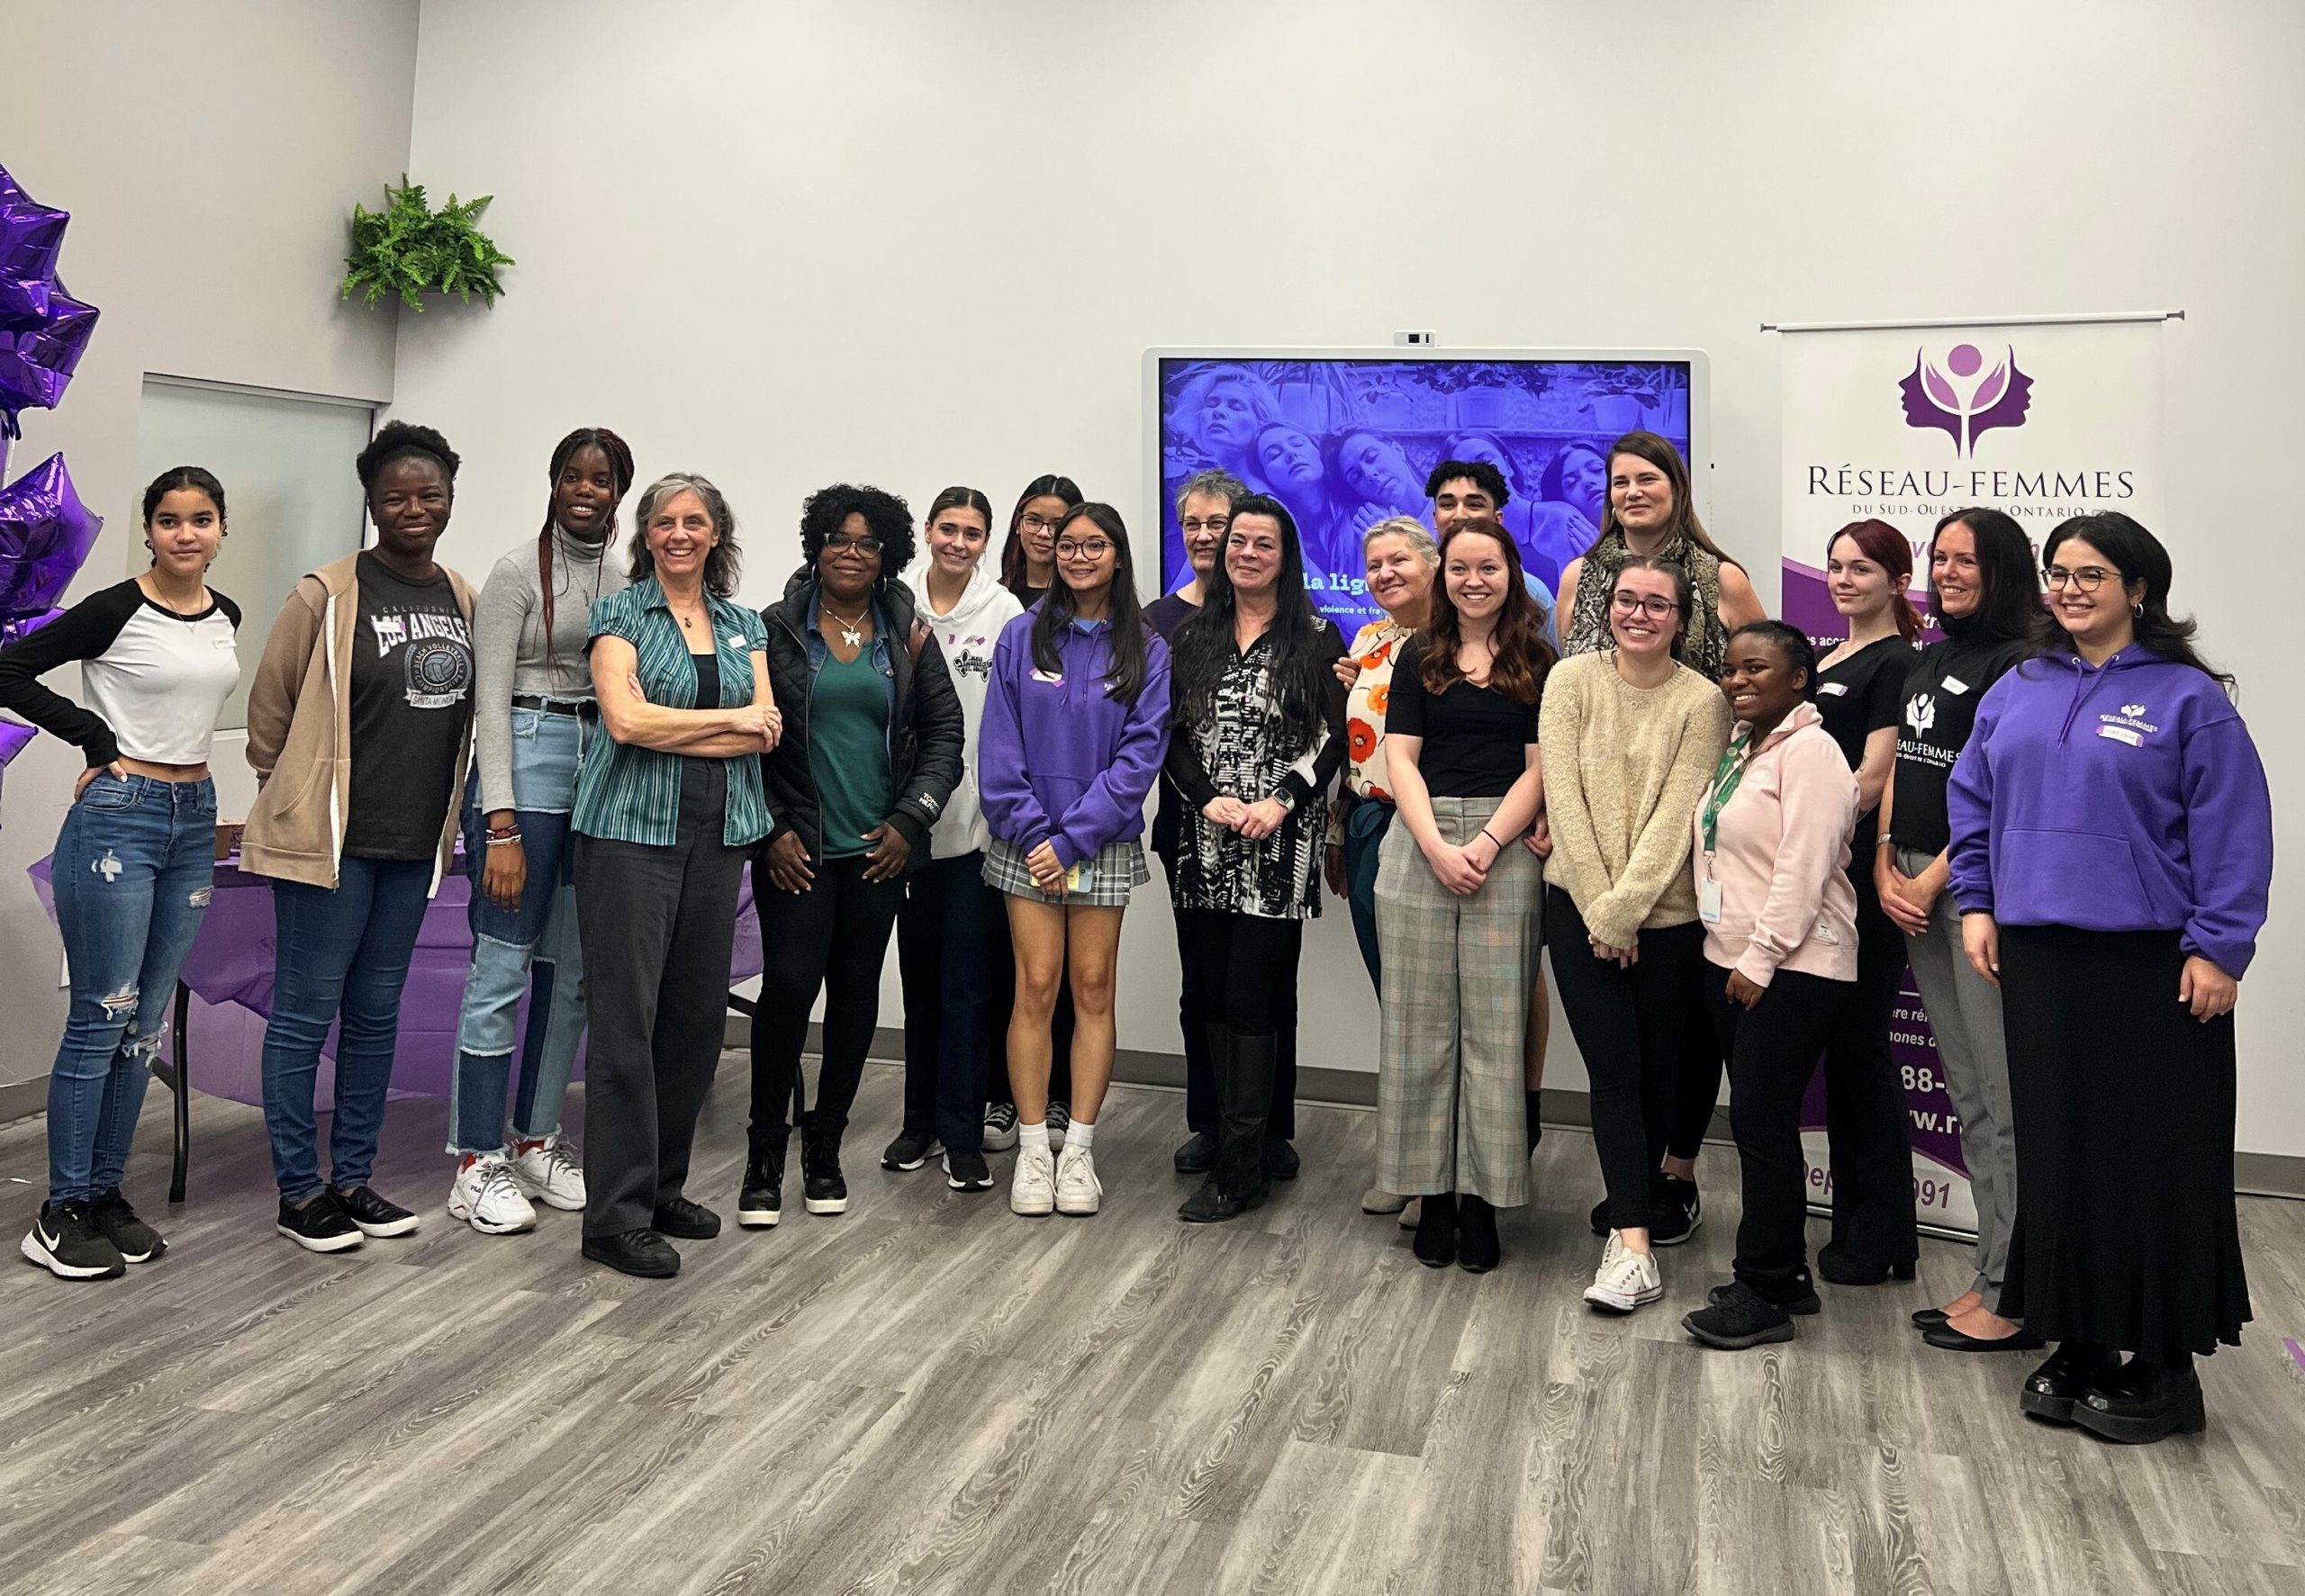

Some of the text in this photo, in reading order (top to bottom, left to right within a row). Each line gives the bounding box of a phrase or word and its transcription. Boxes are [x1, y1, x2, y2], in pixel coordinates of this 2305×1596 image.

[1807, 464, 2135, 499] RÉSEAU-FEMMES
[1852, 504, 1873, 515] DU
[1302, 573, 1324, 590] la
[1319, 604, 1354, 615] violence
[1357, 607, 1367, 615] et
[1893, 1008, 1908, 1019] re
[1901, 1065, 1949, 1095] 88-
[1909, 1109, 1963, 1134] w.r
